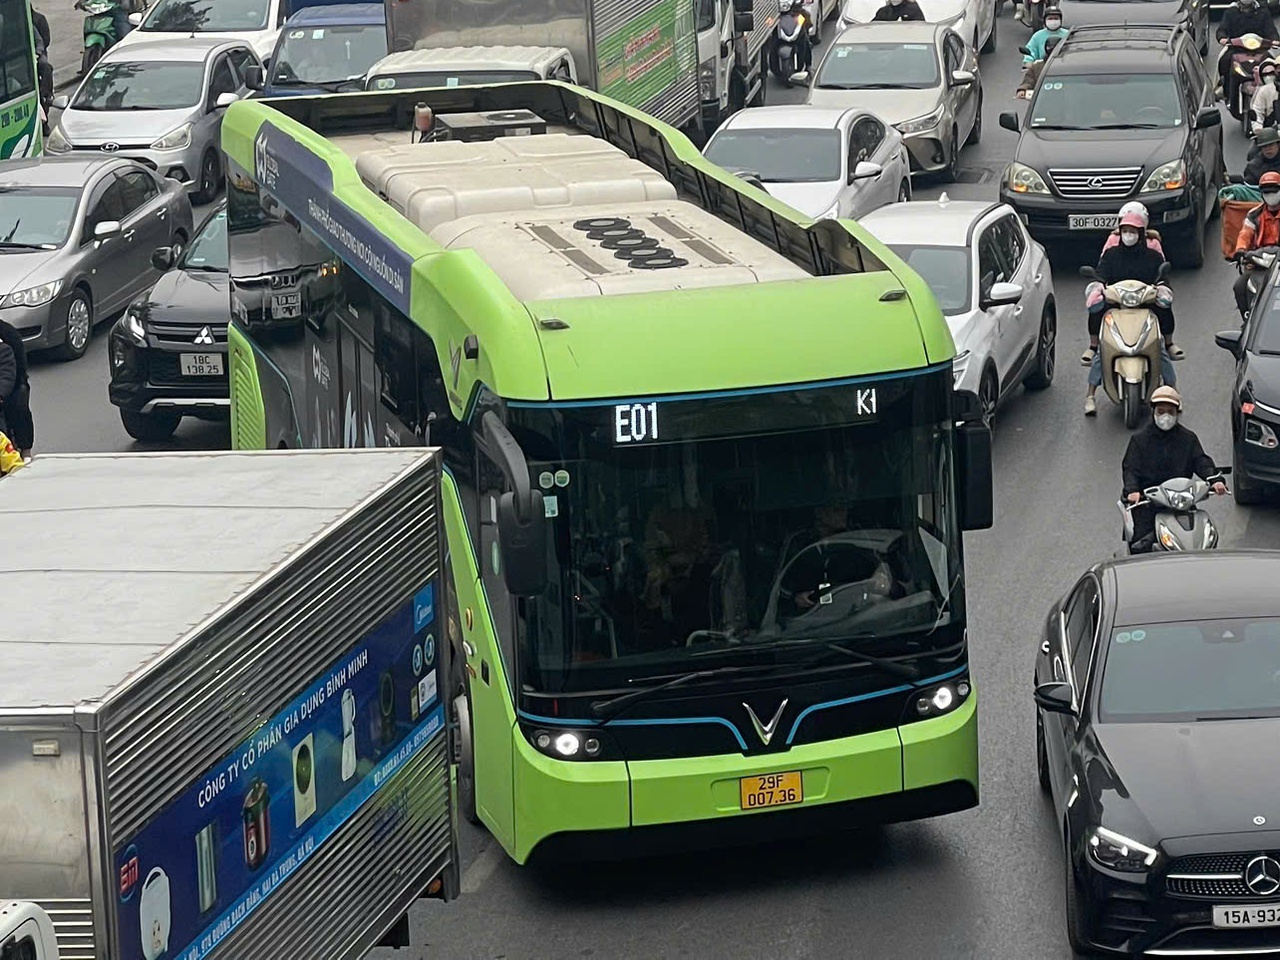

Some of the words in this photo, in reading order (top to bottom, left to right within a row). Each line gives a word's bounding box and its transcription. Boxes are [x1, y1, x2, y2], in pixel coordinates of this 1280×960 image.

[193, 355, 210, 364] 18C
[857, 388, 877, 415] K1
[615, 402, 658, 442] E01
[198, 773, 226, 808] CÔNG
[227, 760, 240, 782] TY
[284, 710, 299, 734] GIA
[301, 688, 325, 718] DỤNG
[326, 670, 347, 698] BÌNH
[348, 649, 368, 677] MINH
[758, 775, 784, 790] 29F
[748, 788, 796, 806] 007.36
